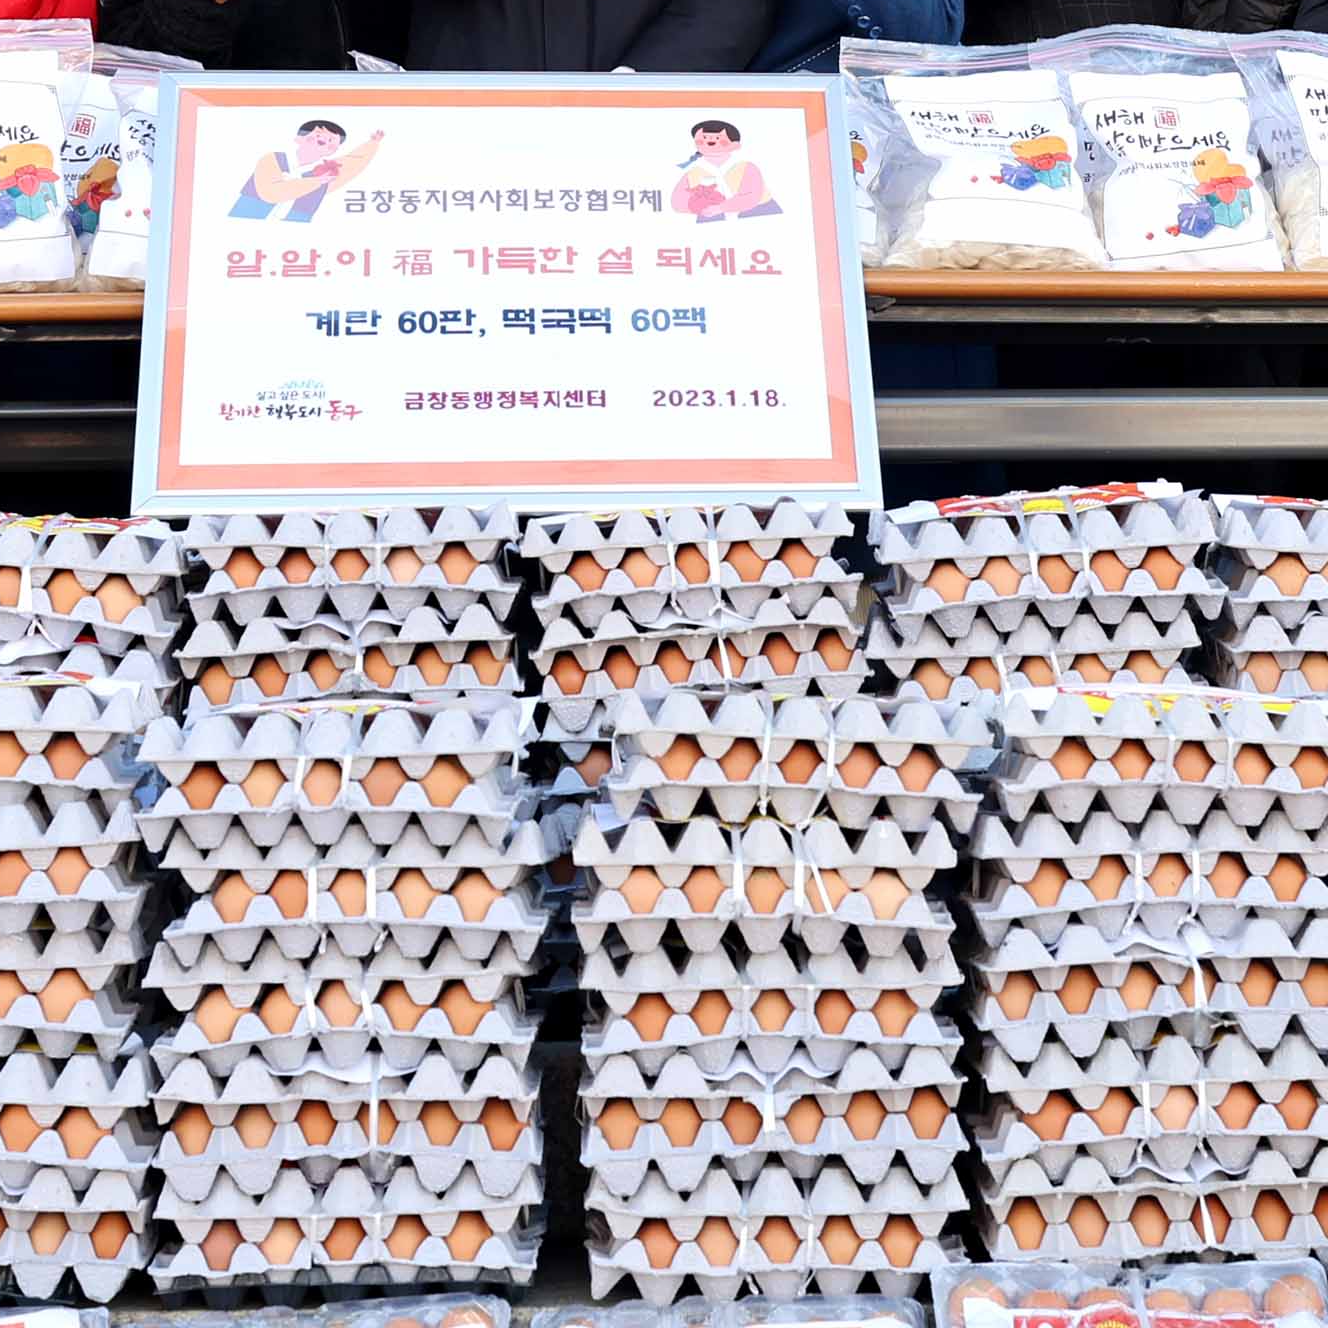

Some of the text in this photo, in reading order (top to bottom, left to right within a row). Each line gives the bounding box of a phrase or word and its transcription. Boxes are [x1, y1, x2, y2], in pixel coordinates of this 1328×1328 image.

[1095, 109, 1145, 130] 새해
[343, 189, 663, 214] 금창동지역사회보장협의체
[226, 246, 783, 278] 알.알.이 福 가득한 설 되세요
[305, 309, 382, 337] 계란
[502, 307, 612, 335] 떡국떡
[631, 307, 707, 335] 60팩
[403, 389, 608, 411] 금창동행정복지센터
